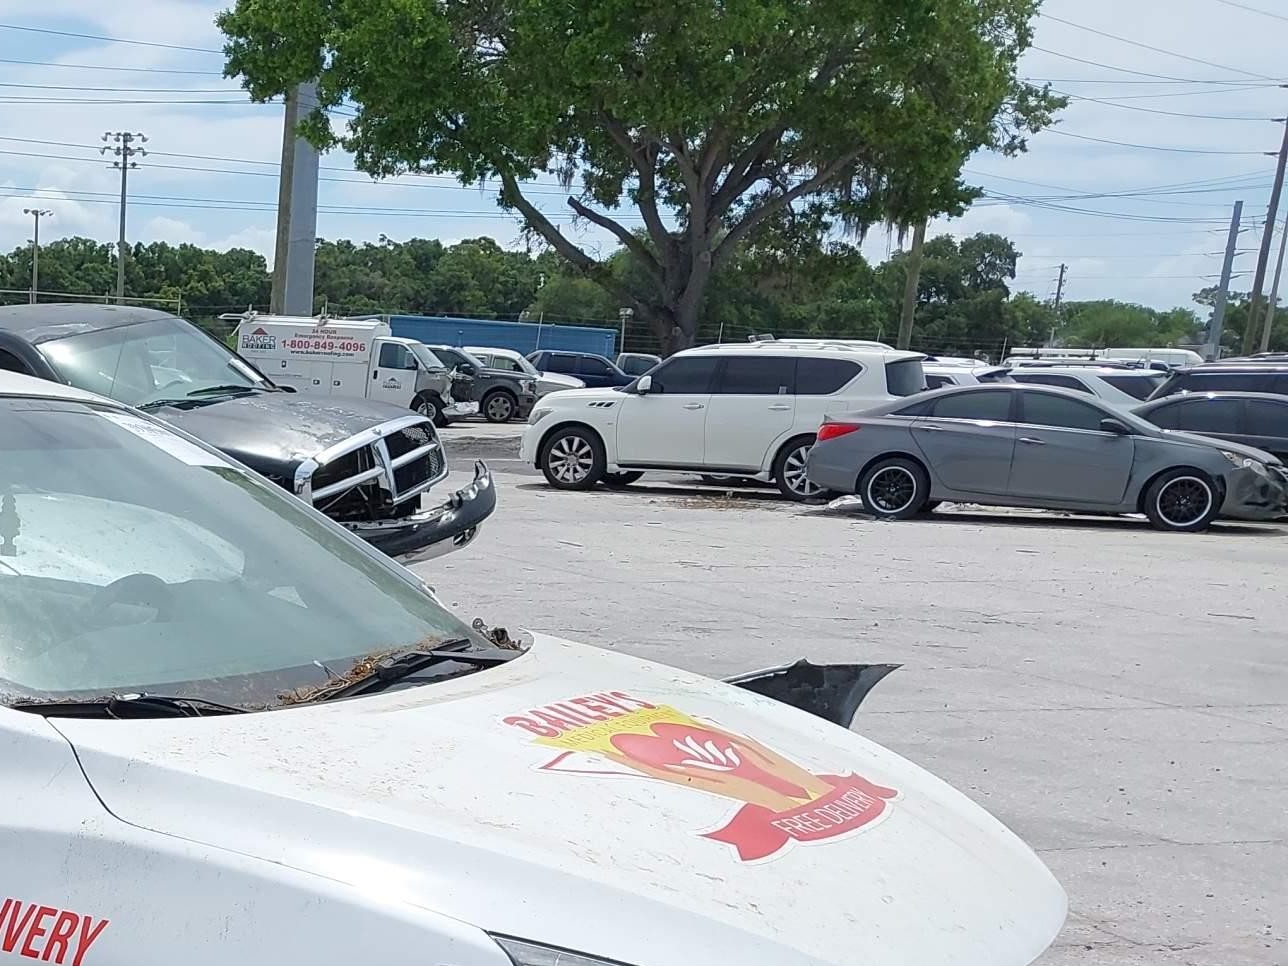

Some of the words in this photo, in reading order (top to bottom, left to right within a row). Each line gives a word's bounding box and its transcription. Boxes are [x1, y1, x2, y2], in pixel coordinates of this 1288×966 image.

[242, 335, 277, 343] BAKER
[281, 340, 366, 352] 1-800-849-4096
[771, 813, 833, 837] FREE
[813, 786, 878, 825] DELIVERY
